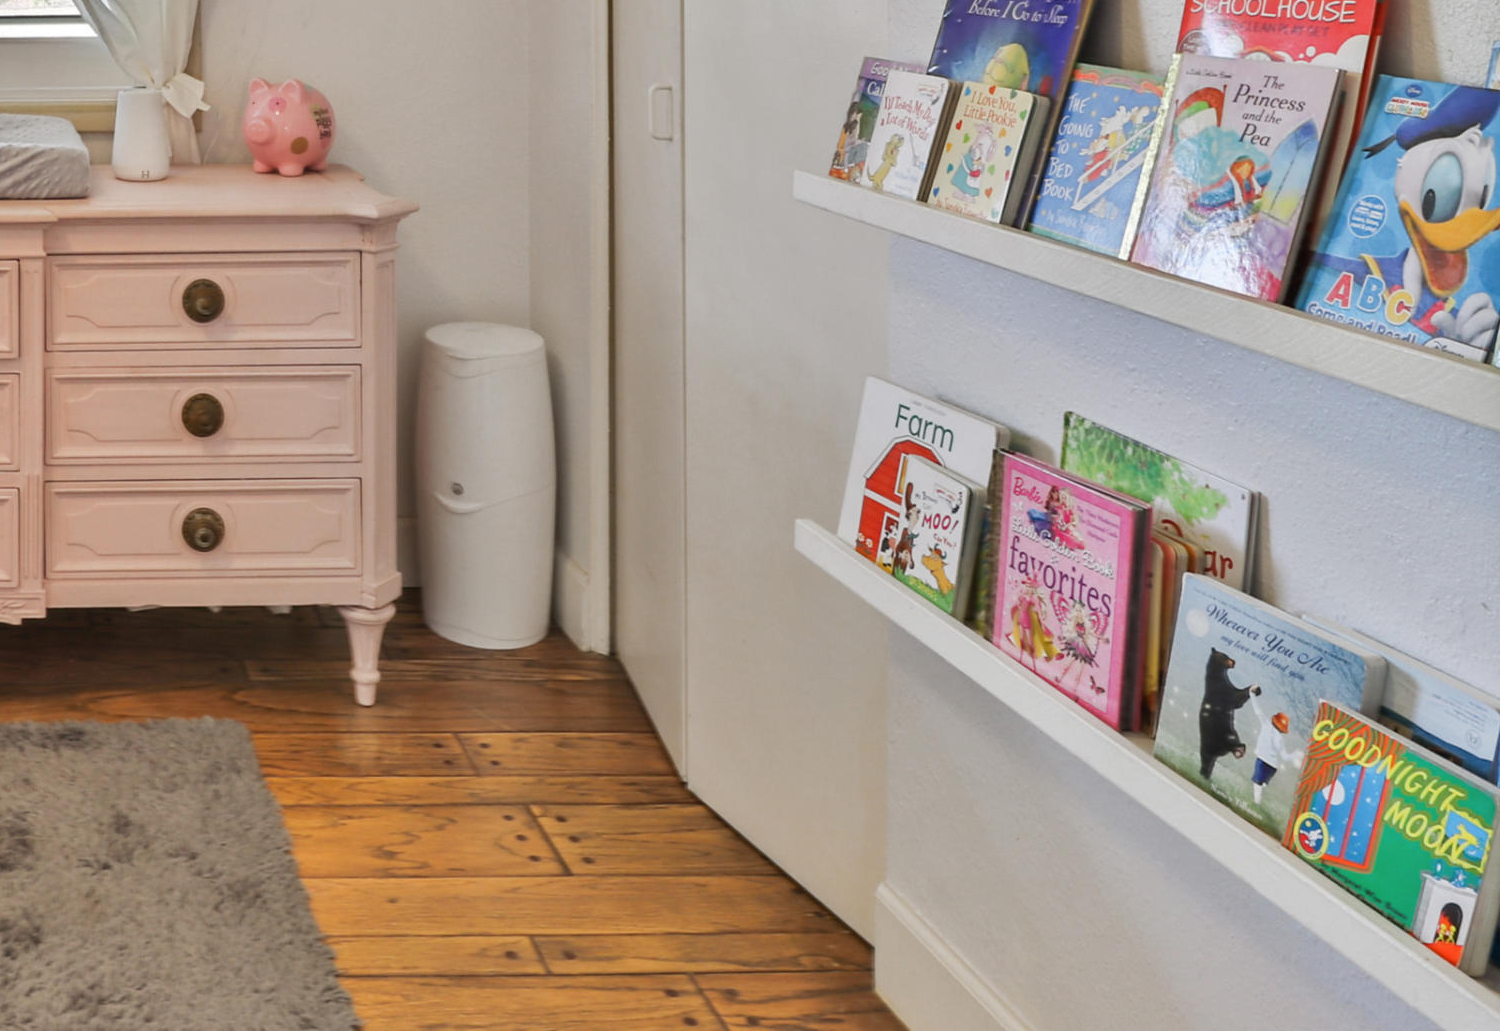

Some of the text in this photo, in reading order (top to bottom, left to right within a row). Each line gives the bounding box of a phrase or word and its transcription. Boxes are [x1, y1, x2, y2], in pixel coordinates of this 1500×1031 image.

[1001, 0, 1013, 18] I
[1011, 0, 1029, 20] Go
[1031, 10, 1042, 22] to
[1044, 4, 1068, 27] Sleep
[867, 81, 885, 97] Cal
[1263, 75, 1284, 90] The
[971, 90, 976, 103] I
[977, 92, 998, 108] Love
[1069, 93, 1091, 113] THE
[1232, 83, 1306, 112] Princess
[964, 105, 987, 120] Little
[1242, 109, 1282, 124] and the
[1058, 115, 1095, 138] GOING
[1239, 123, 1271, 147] Pea
[1056, 140, 1069, 154] TO
[1048, 156, 1074, 178] BED
[1042, 178, 1075, 201] BOOK
[895, 403, 954, 452] Farm
[1013, 477, 1044, 505] Barbie
[922, 512, 959, 534] MOO!
[1204, 550, 1234, 579] ar
[1008, 535, 1112, 618] favorites
[1206, 603, 1260, 641] Wherever
[1261, 633, 1294, 658] You
[1297, 653, 1331, 675] Are
[1312, 719, 1467, 812] GOODNIGHT
[1383, 800, 1470, 862] MOON
